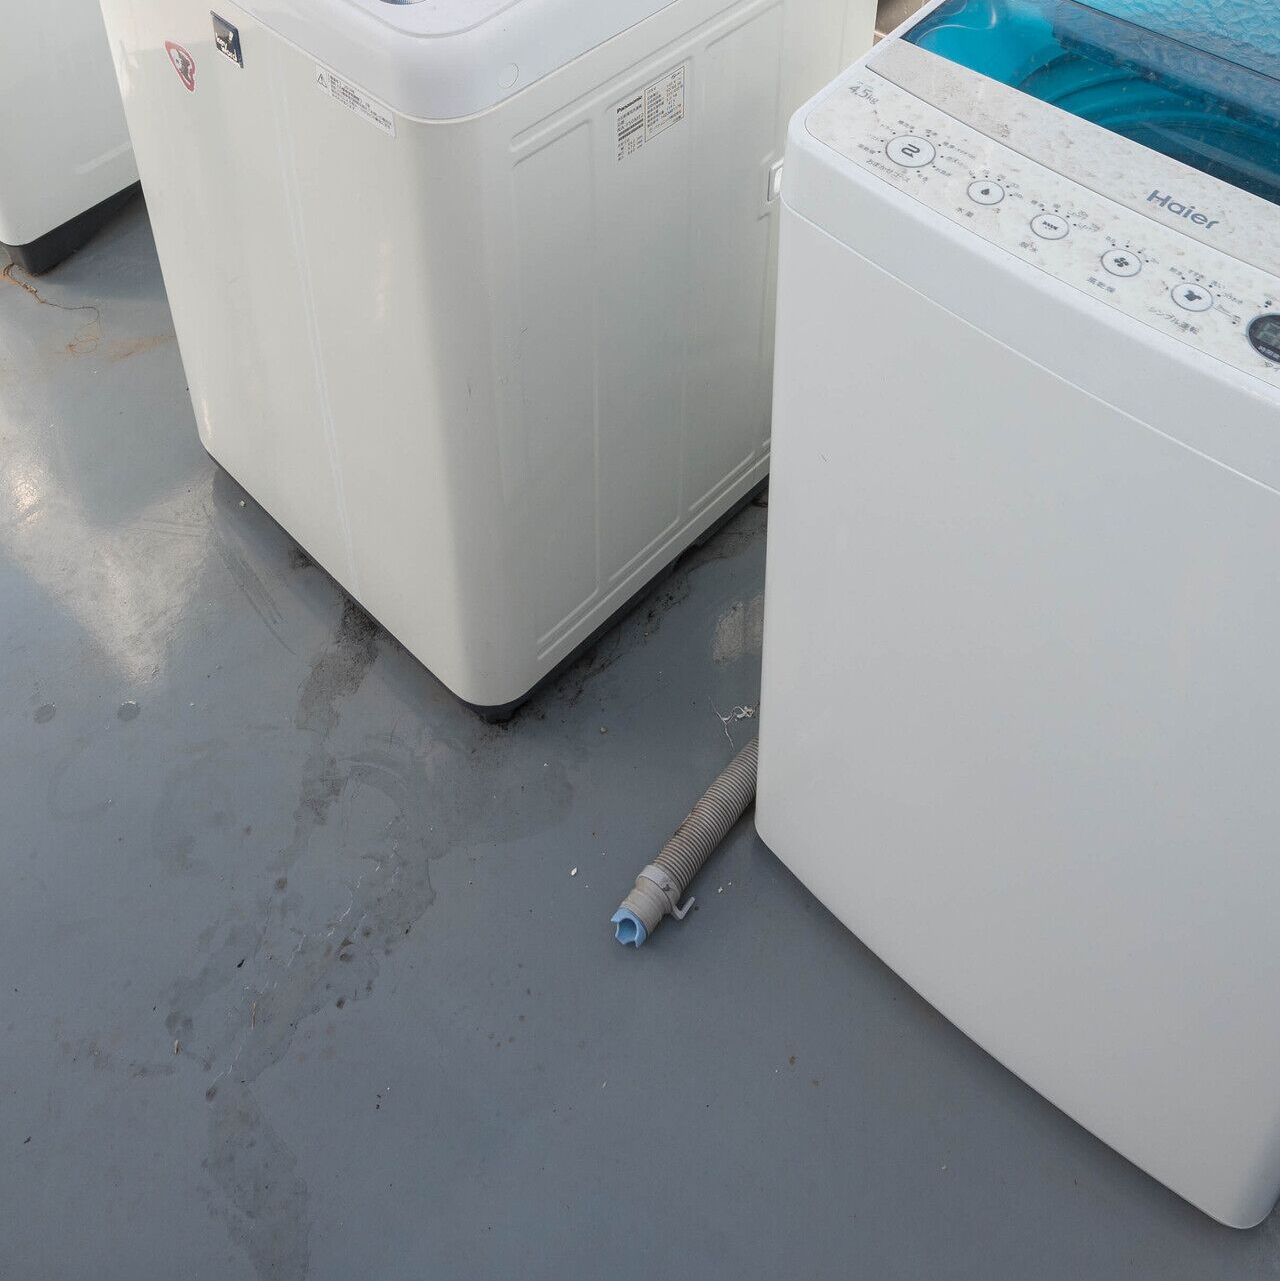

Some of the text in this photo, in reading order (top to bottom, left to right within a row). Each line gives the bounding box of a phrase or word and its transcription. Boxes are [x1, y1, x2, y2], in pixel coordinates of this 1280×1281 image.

[848, 85, 879, 105] 4.5kg
[1146, 189, 1220, 230] Haier
[1148, 307, 1200, 335] シンプル運転
